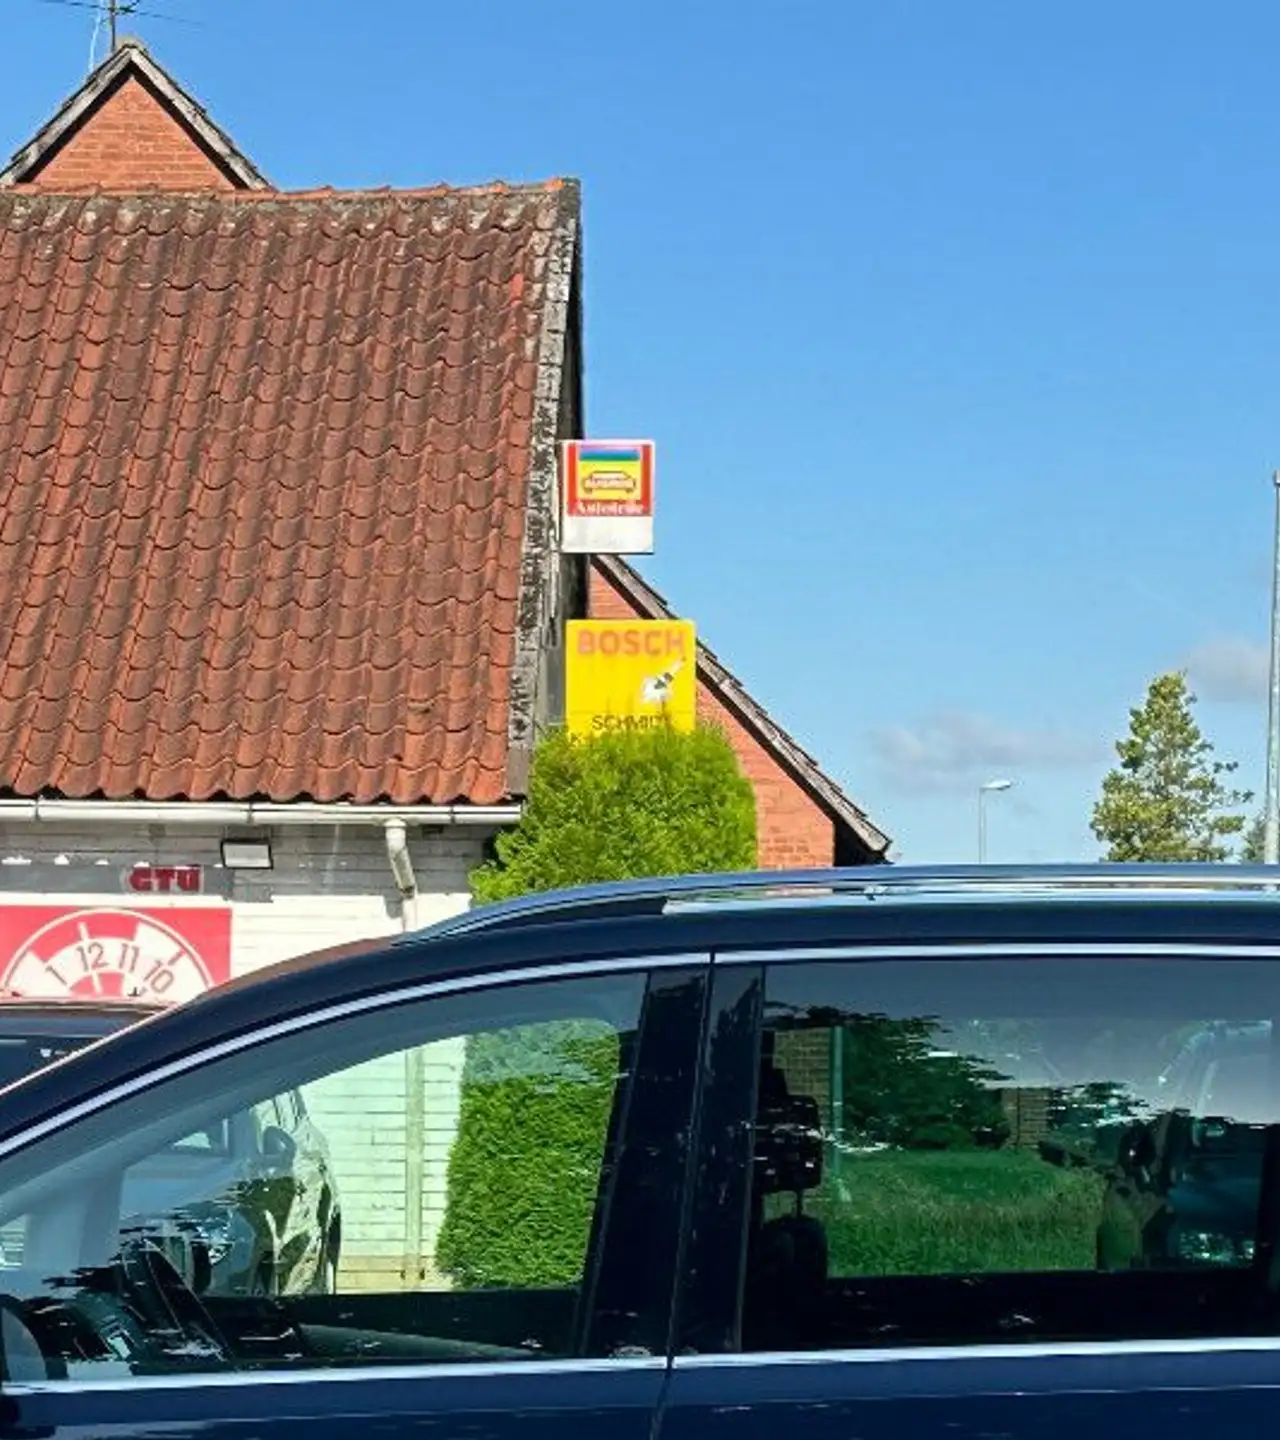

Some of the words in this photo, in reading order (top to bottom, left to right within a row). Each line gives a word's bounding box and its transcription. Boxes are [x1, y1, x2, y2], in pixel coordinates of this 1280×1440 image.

[577, 628, 685, 656] BOSCH
[76, 941, 109, 972] 12
[119, 942, 140, 973] 11
[143, 960, 175, 993] 10
